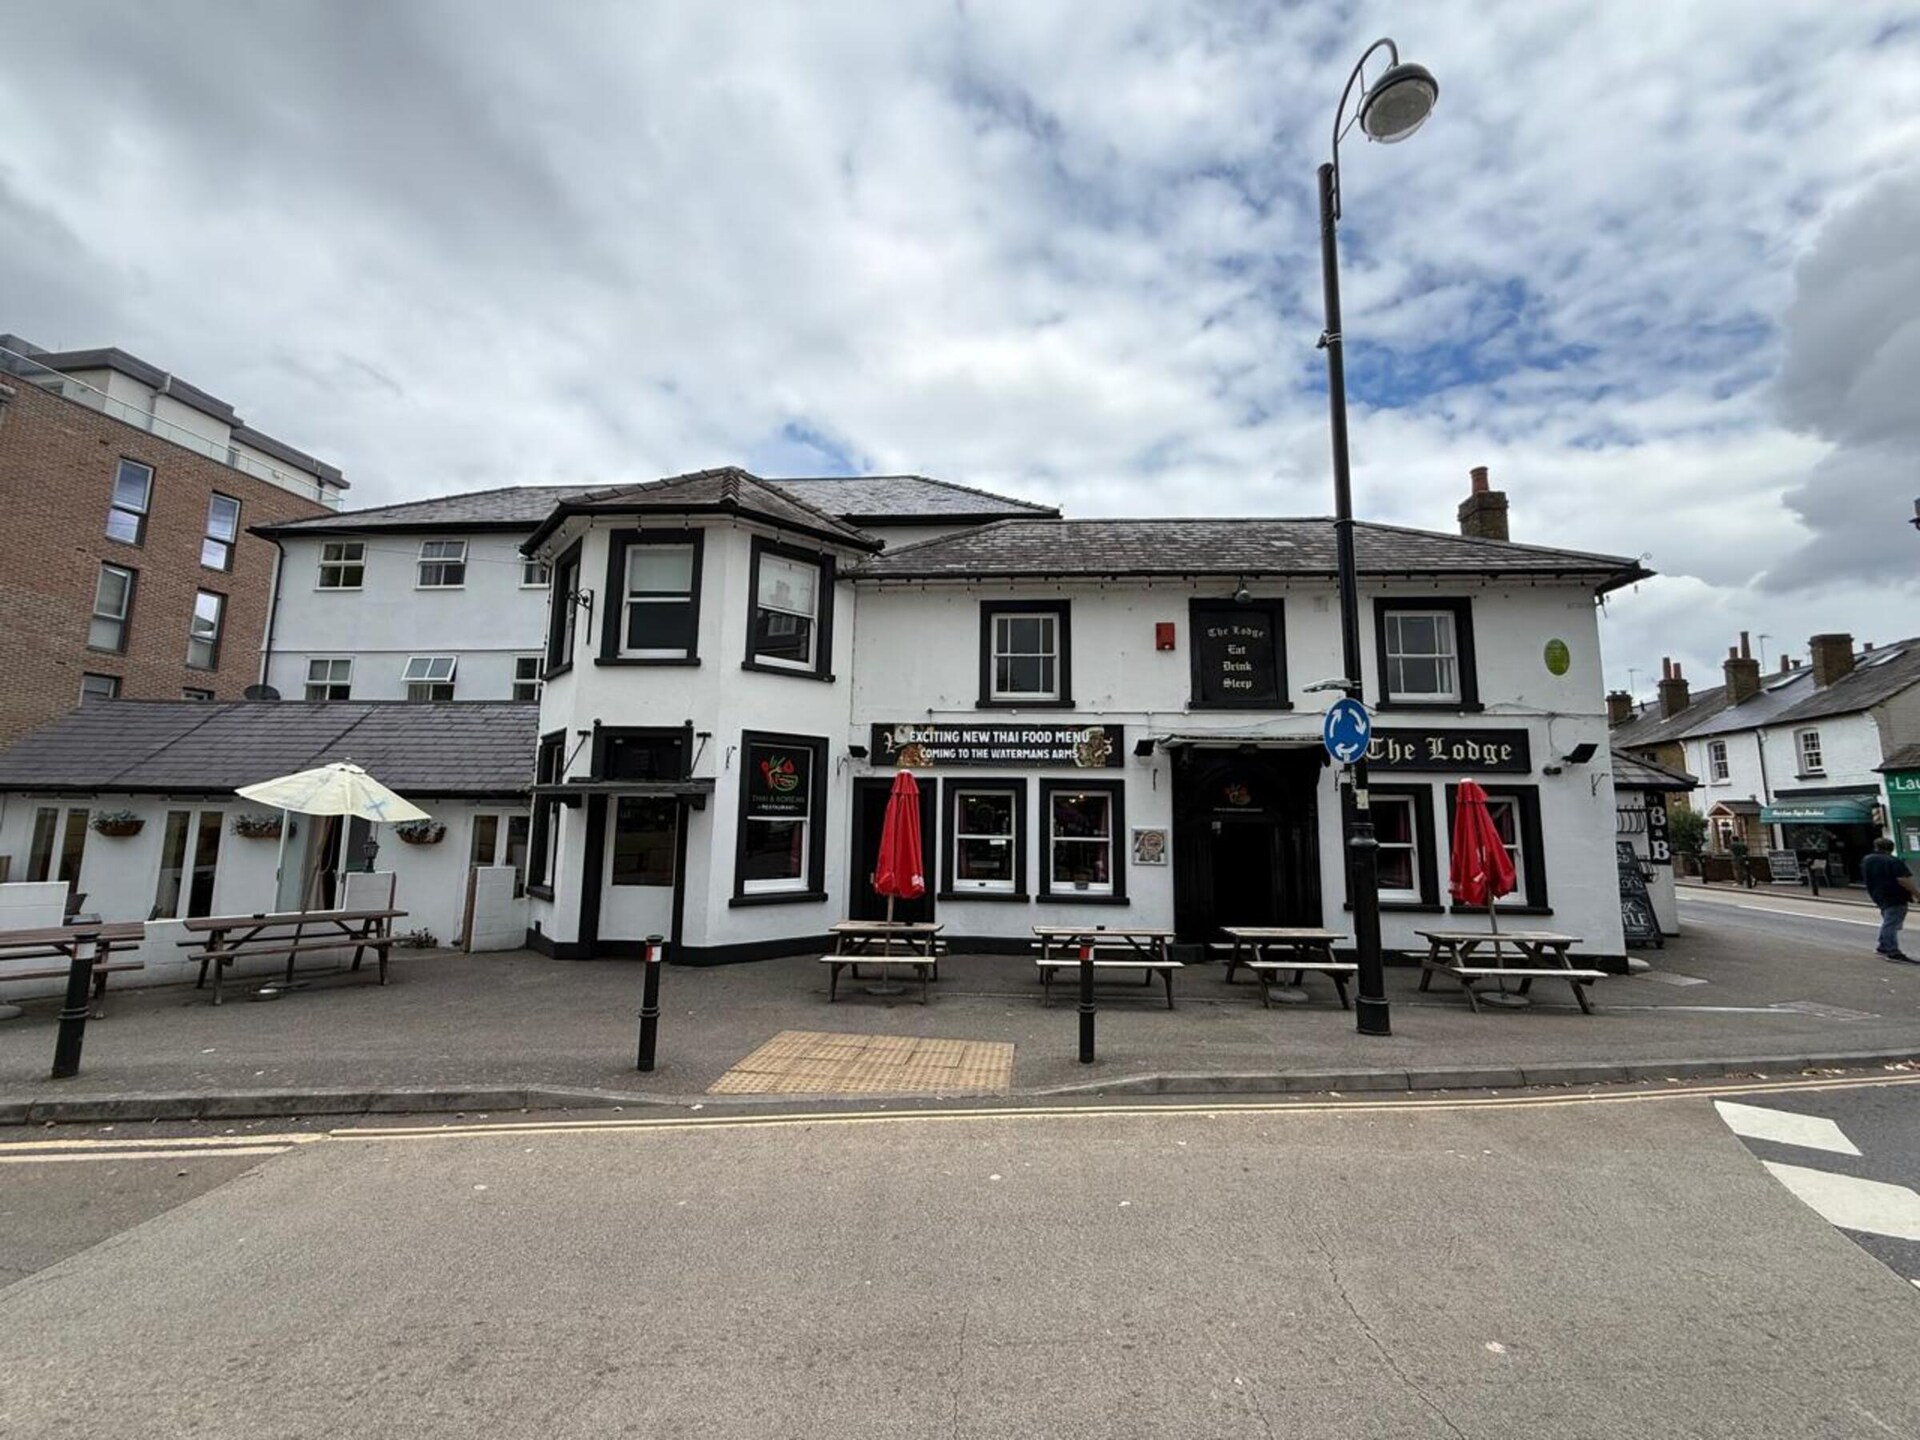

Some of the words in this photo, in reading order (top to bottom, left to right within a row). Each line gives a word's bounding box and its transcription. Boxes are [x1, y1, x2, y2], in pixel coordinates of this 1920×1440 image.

[1207, 627, 1229, 638] The
[1232, 625, 1264, 638] Lodge
[1227, 644, 1246, 655] Eat
[1222, 661, 1252, 672] Drink
[1222, 677, 1252, 689] Sleep
[909, 730, 960, 743] EXCITING
[962, 730, 990, 743] NEW
[993, 731, 1020, 743] THAI
[1021, 731, 1053, 743] FOOD
[1055, 731, 1090, 743] MENU
[920, 748, 957, 758] COMING
[958, 748, 970, 758] TO
[971, 748, 989, 758] THE
[991, 748, 1050, 759] WATERMANS
[1052, 748, 1079, 759] ARMS
[1366, 736, 1416, 764] The
[1425, 737, 1512, 765] Lodge
